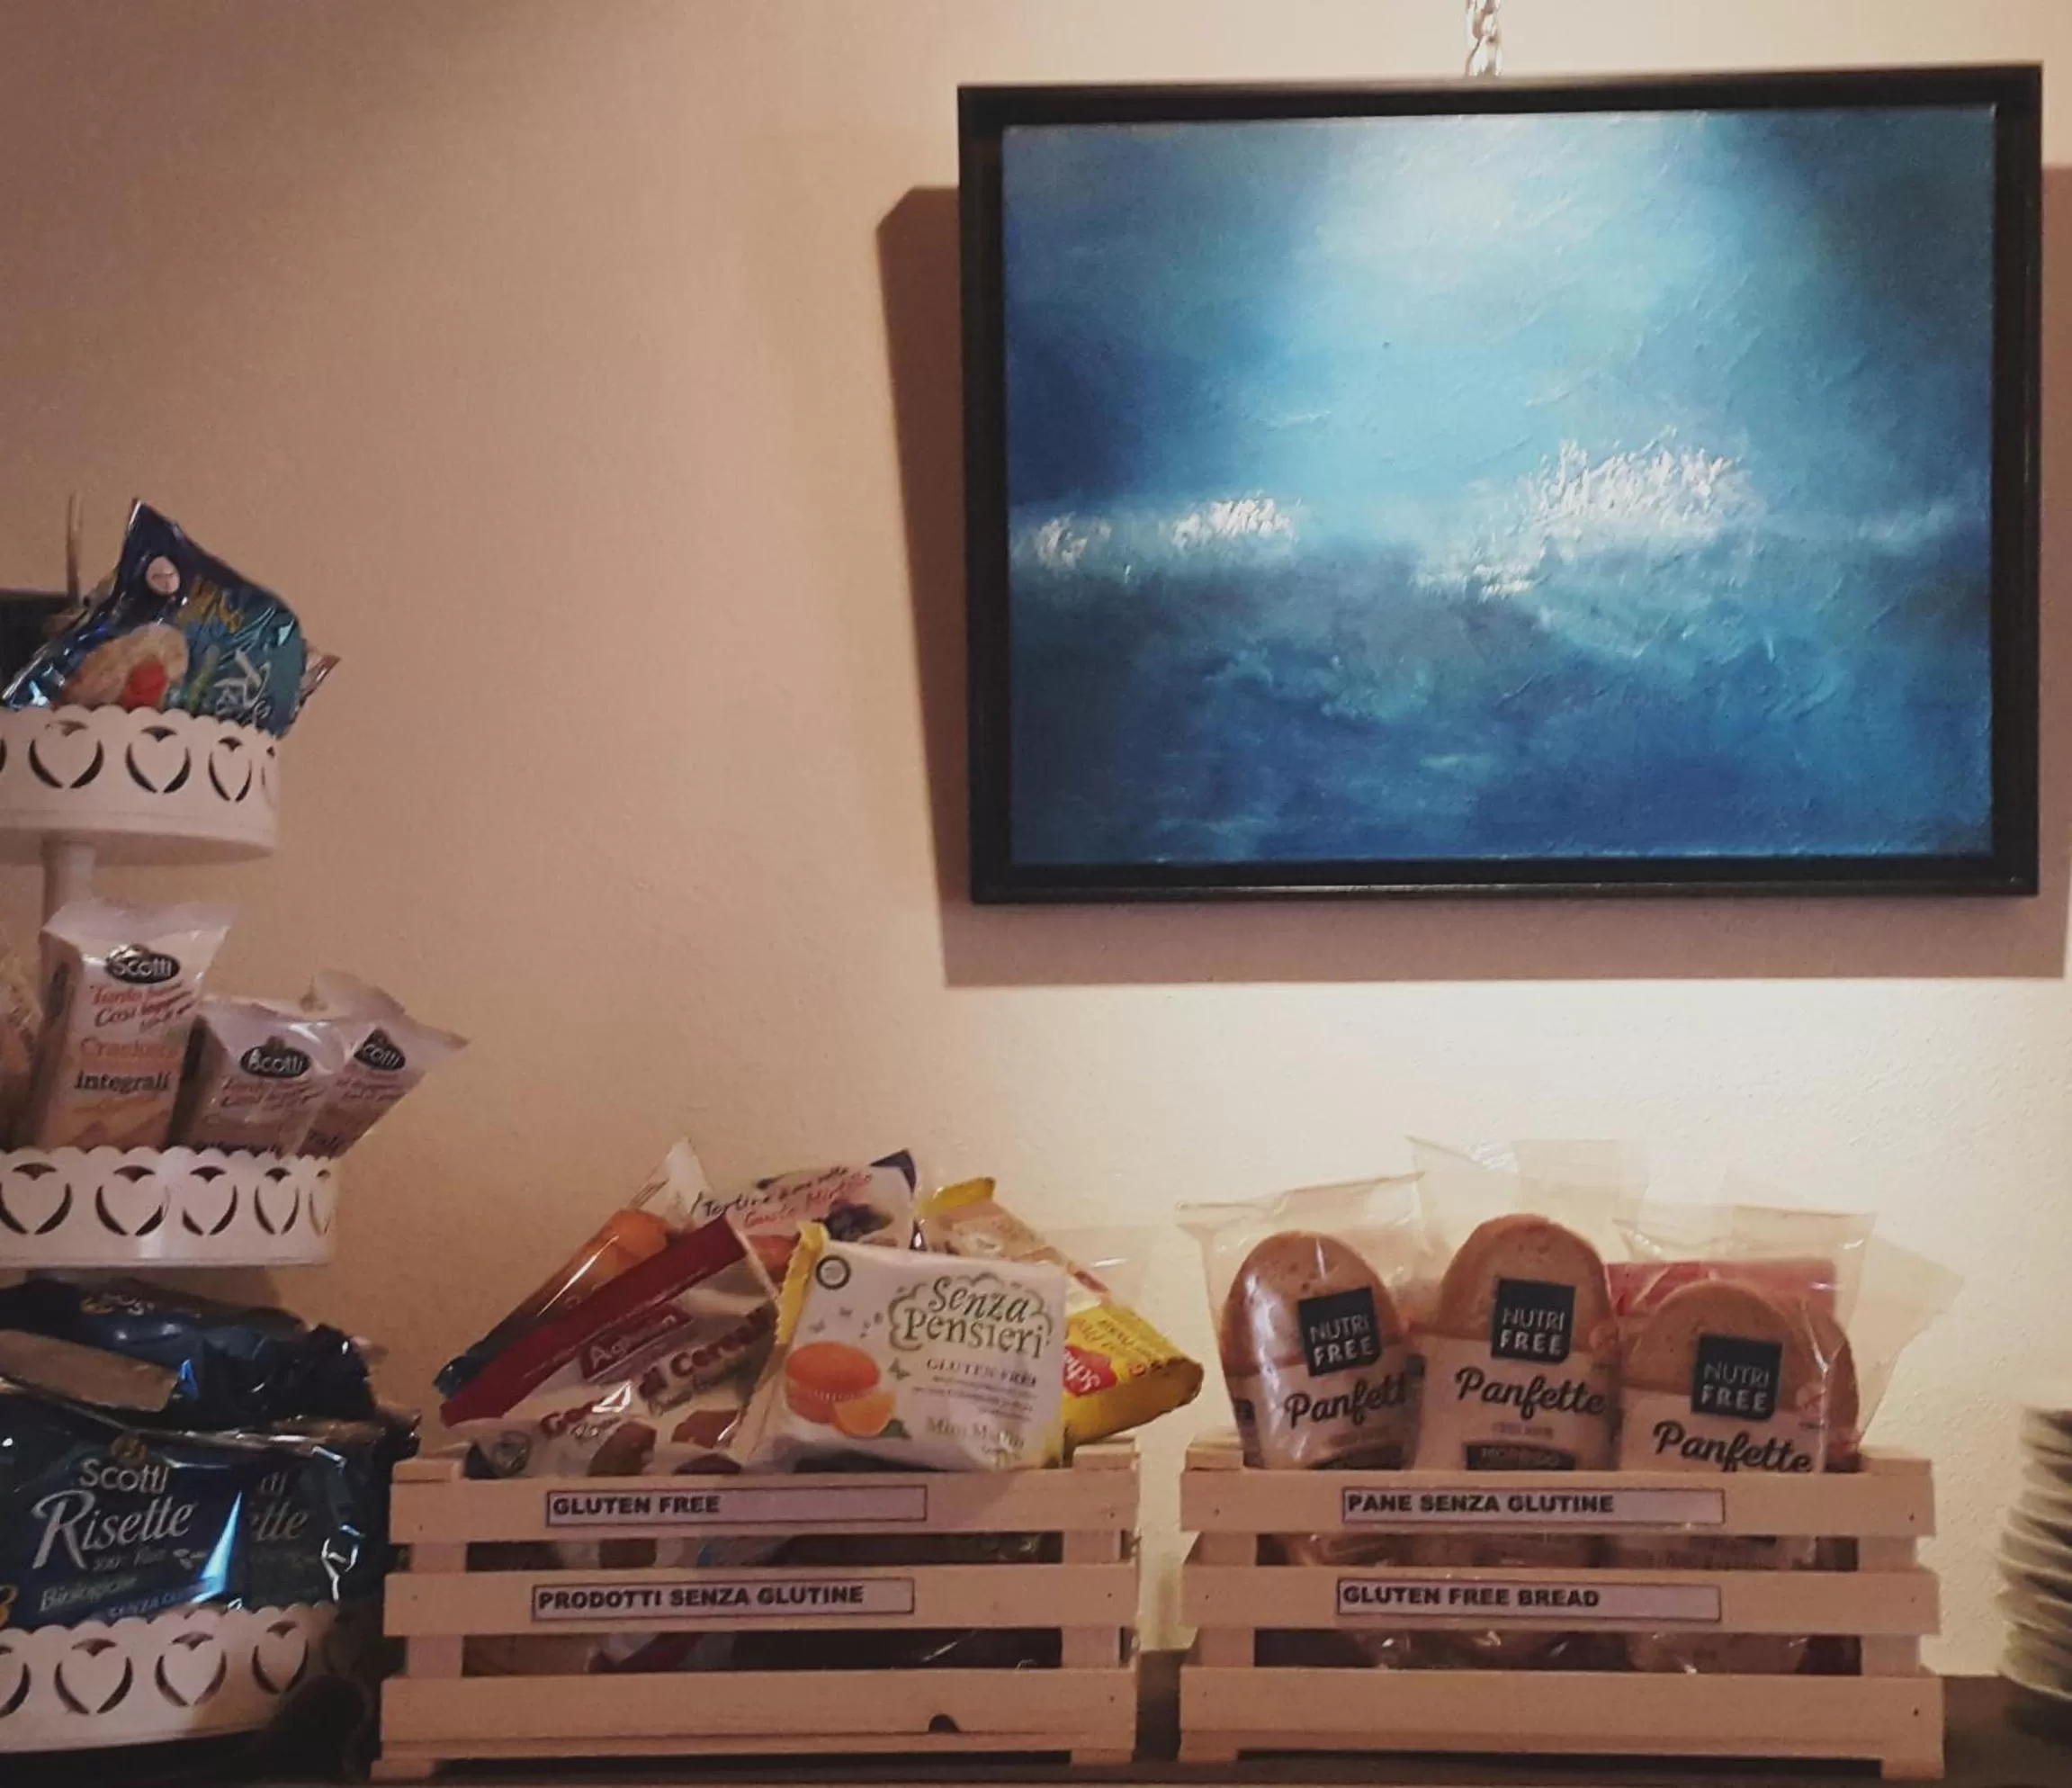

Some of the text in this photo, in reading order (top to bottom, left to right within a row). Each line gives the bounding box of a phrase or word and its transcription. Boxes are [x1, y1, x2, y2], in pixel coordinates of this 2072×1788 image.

[928, 1276, 1030, 1324] Senza
[903, 1307, 1044, 1359] Pensieri
[1310, 1314, 1370, 1343] NUTRI
[1502, 1307, 1565, 1332] NUTRI
[1313, 1336, 1373, 1368] FREE
[1500, 1329, 1565, 1355] FREE
[1703, 1361, 1770, 1388] NUTRI
[1284, 1378, 1406, 1430] Panfett
[1455, 1367, 1606, 1420] Panfette
[1701, 1383, 1768, 1413] FREE
[1653, 1420, 1813, 1472] Panfette
[77, 1457, 170, 1495] Scotti
[552, 1495, 721, 1516] GLUTEN FREE
[1348, 1494, 1615, 1514] PANE SENZA GLUTINE
[31, 1488, 199, 1570] Risette
[538, 1586, 865, 1610] PRODOTTI SENZA GLUTINE
[1342, 1586, 1601, 1608] GLUTEN FREE BREAD
